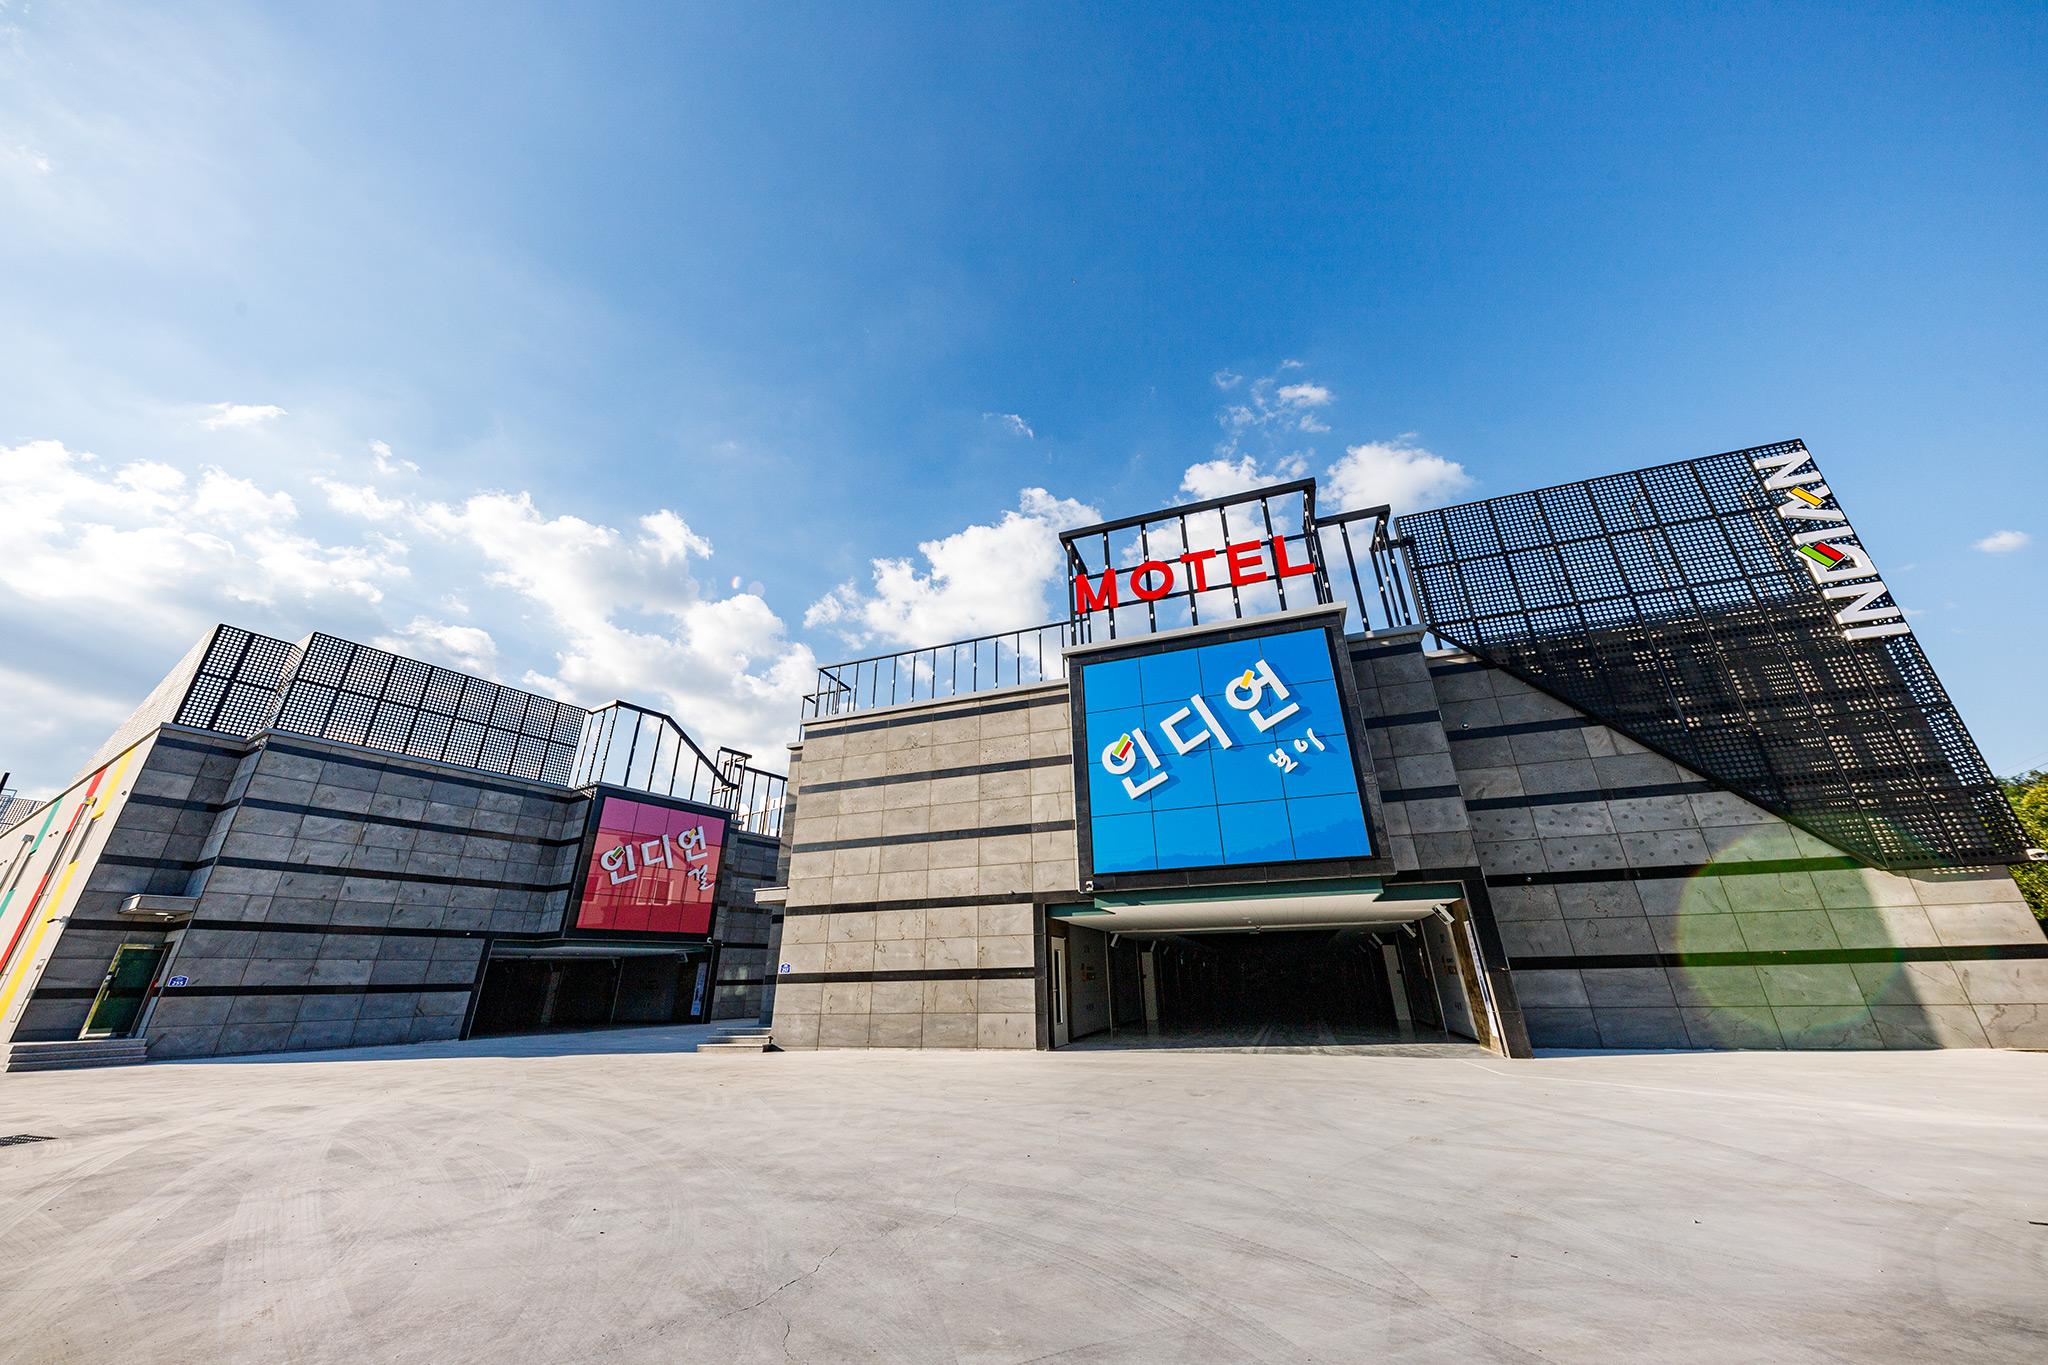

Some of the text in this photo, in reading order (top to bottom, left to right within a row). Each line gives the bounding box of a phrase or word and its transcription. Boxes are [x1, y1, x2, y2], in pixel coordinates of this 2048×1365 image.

[1075, 535, 1316, 614] MOTEL
[1754, 450, 1910, 641] INDIAN
[1102, 658, 1300, 800] 인디언
[601, 825, 708, 885] 인디언
